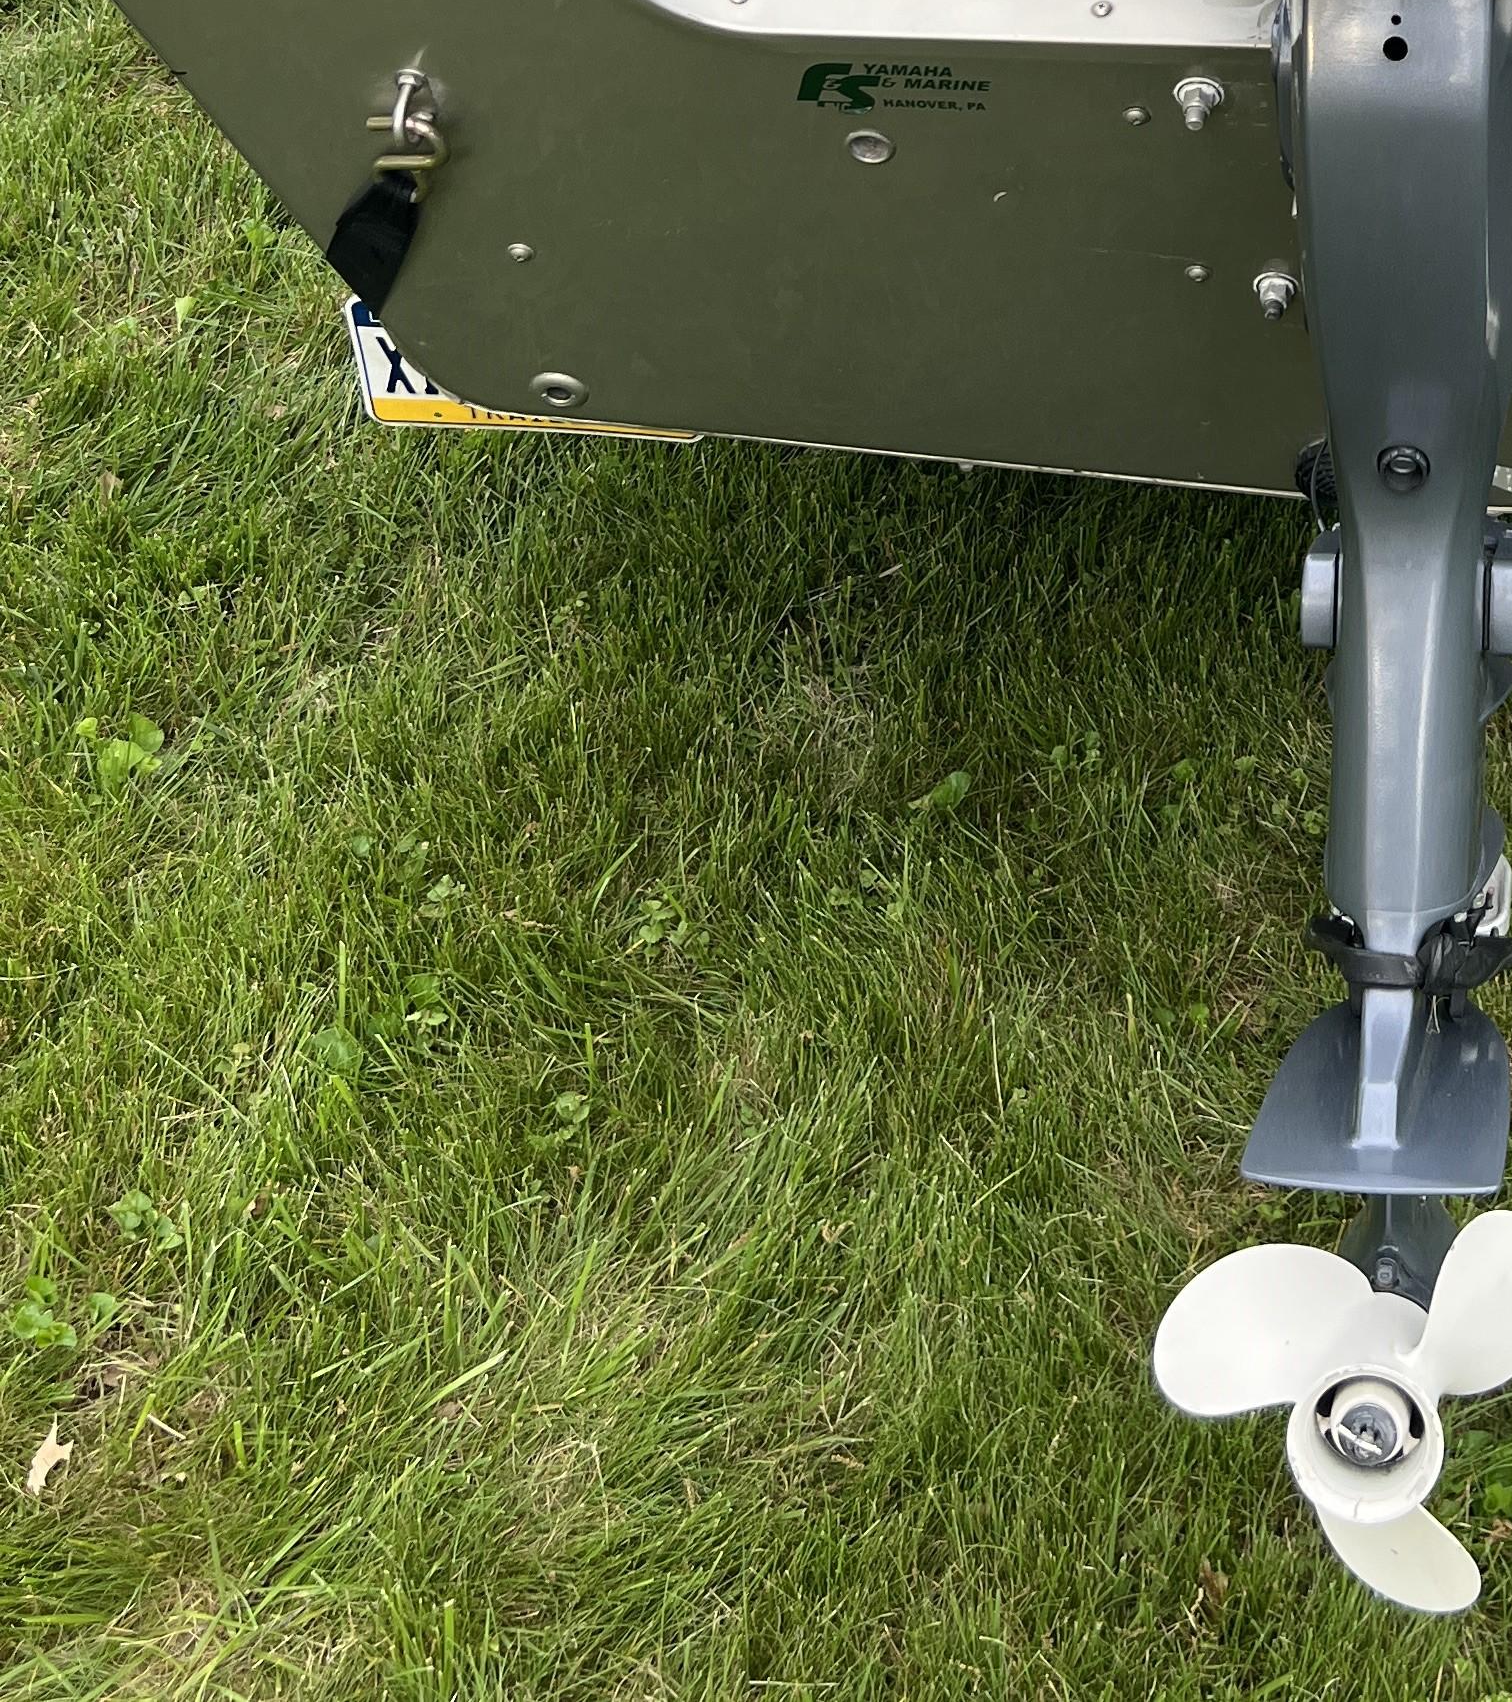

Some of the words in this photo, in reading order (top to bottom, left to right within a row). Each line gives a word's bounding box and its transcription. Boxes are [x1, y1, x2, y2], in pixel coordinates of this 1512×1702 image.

[863, 63, 953, 78] YAMAHA
[881, 77, 897, 89] &
[903, 77, 993, 92] MARINE
[883, 99, 963, 112] HANOVER,
[966, 101, 987, 112] PA
